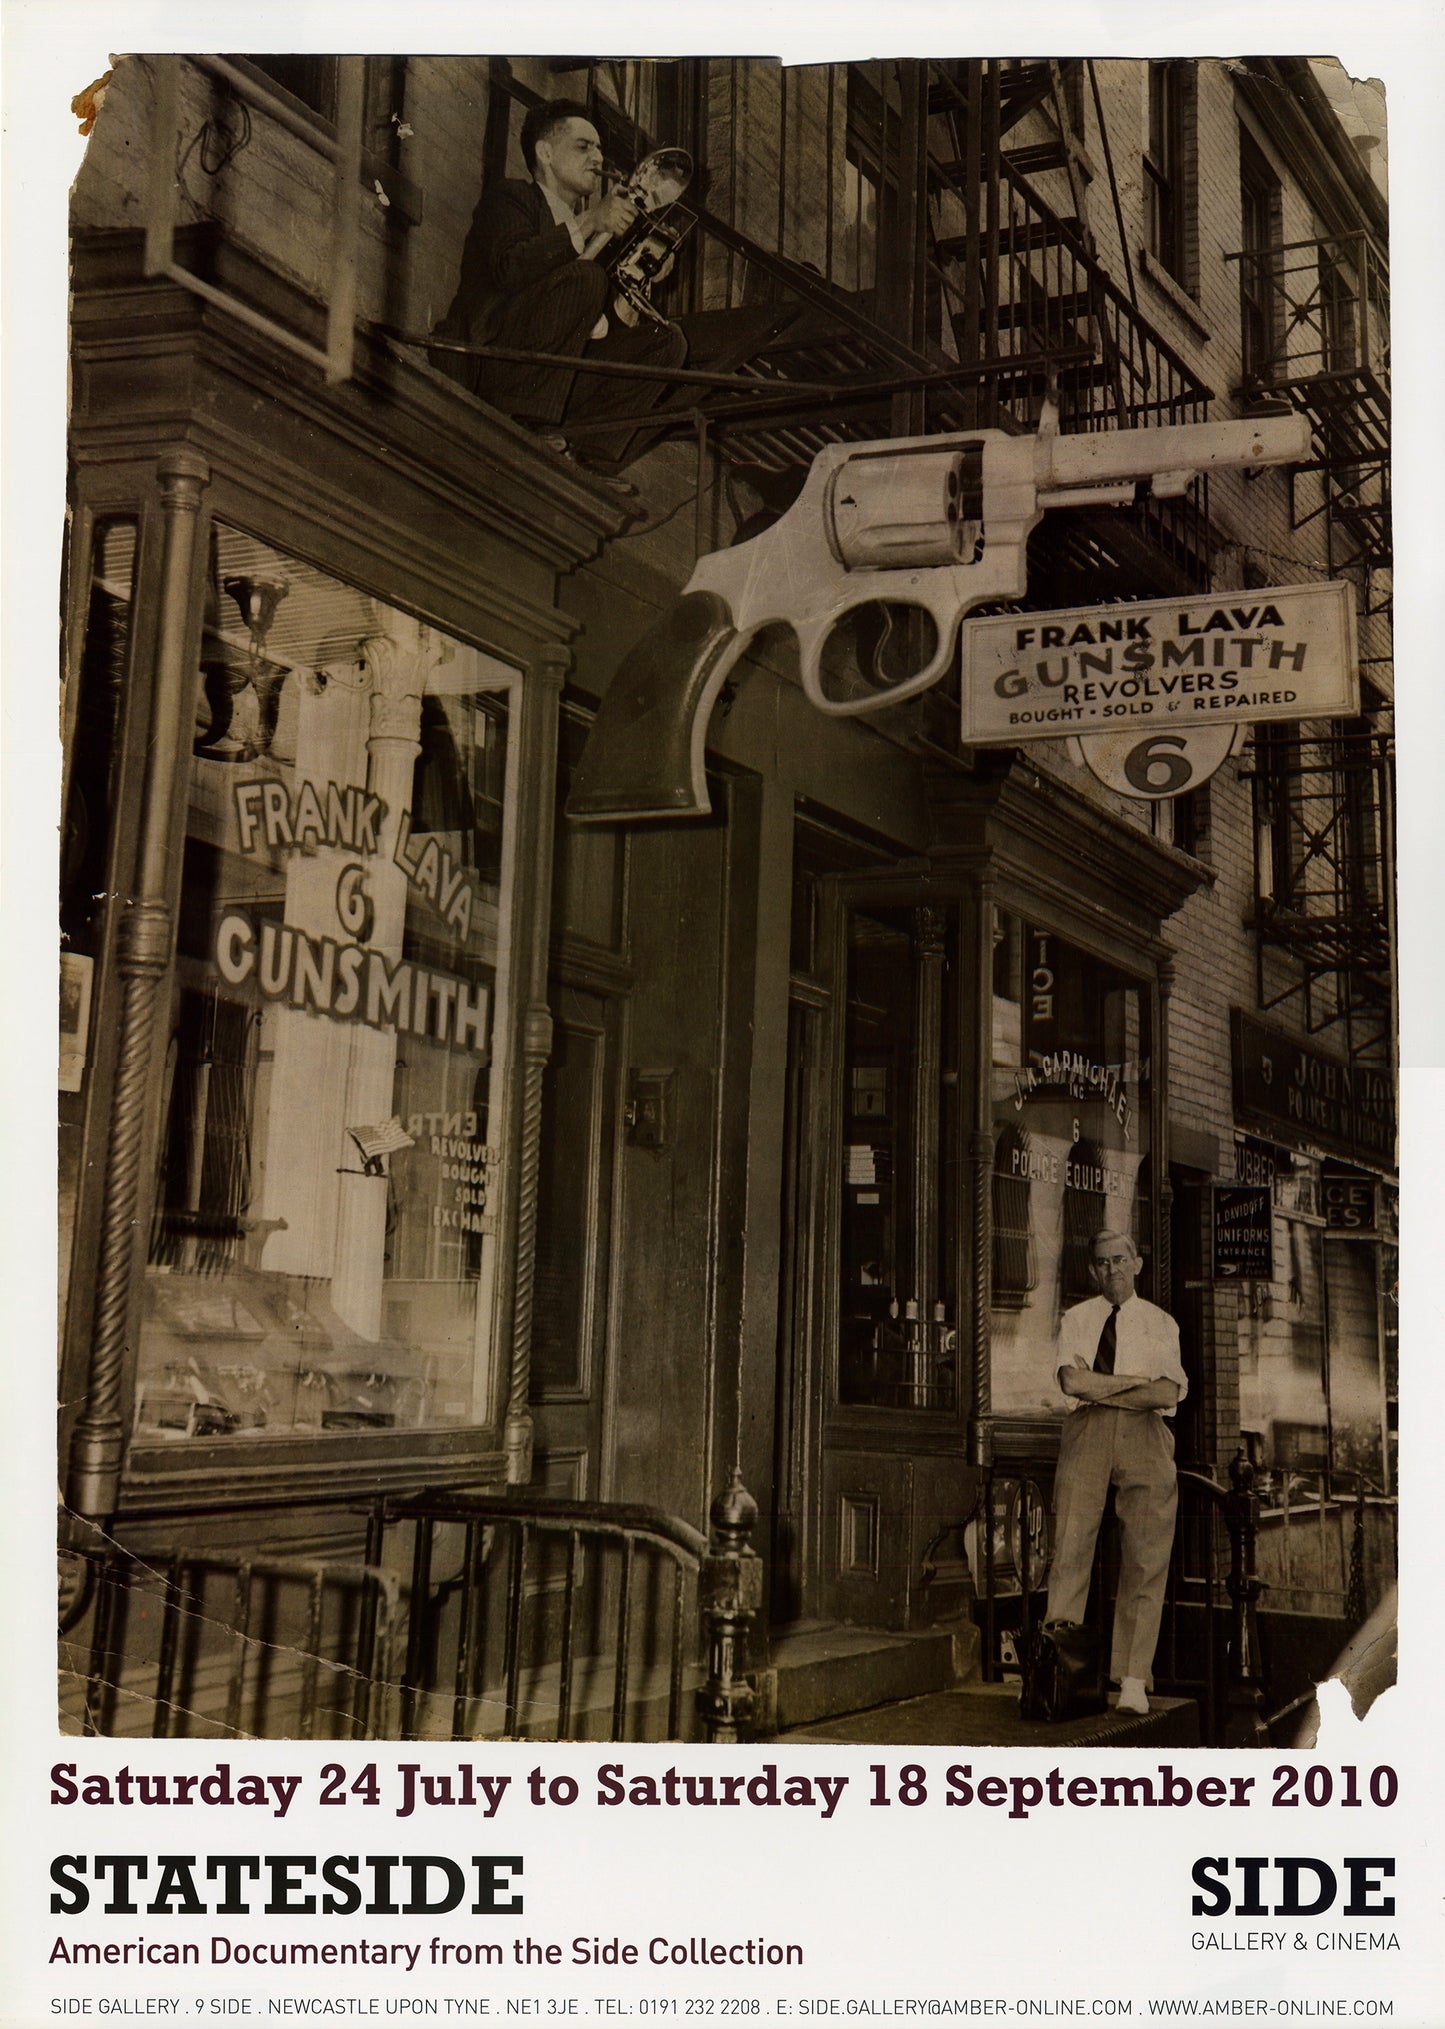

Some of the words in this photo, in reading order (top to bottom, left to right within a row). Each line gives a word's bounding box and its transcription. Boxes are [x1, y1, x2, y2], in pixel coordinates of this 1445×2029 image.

[1016, 617, 1152, 651] FRANK
[1178, 605, 1285, 636] LAVA
[993, 636, 1308, 700] GUNSMITH
[1062, 670, 1240, 705] REVOLVERS
[1008, 707, 1084, 725] BOUGHT
[1102, 701, 1154, 718] SOLD
[1193, 690, 1298, 710] REPAIRED
[1124, 735, 1193, 794] 6
[234, 779, 381, 855] FRANK
[393, 808, 474, 943] LAVA
[336, 863, 376, 943] 6
[216, 908, 492, 1056] GUNSMITH
[1294, 1053, 1351, 1105] JOHN
[1072, 1117, 1081, 1144] 6
[1012, 1148, 1059, 1185] POLICE
[1065, 1159, 1133, 1202] EQUIPMENT
[1326, 1185, 1368, 1206] CE
[455, 1186, 487, 1206] SOLD
[1224, 1195, 1265, 1223] DAVIDOFF
[1217, 1227, 1269, 1244] UNIFORMS
[1217, 1247, 1266, 1257] ENTRANCE
[51, 1763, 302, 1818] Saturday
[320, 1764, 380, 1806] 24
[396, 1764, 511, 1818] July
[527, 1766, 578, 1806] to
[598, 1764, 849, 1819] Saturday
[870, 1765, 928, 1806] 18
[946, 1765, 1255, 1819] September
[1272, 1765, 1398, 1807] 2010
[50, 1855, 524, 1916] STATESIDE
[1192, 1857, 1396, 1917] SIDE
[49, 1936, 200, 1965] American
[212, 1937, 421, 1972] Documentary
[430, 1936, 502, 1965] from
[513, 1937, 562, 1965] the
[572, 1936, 638, 1965] Side
[649, 1937, 803, 1966] Collection
[1192, 1932, 1286, 1951] GALLERY
[1294, 1932, 1308, 1951] &
[1316, 1932, 1401, 1951] CINEMA
[51, 1998, 93, 2015] SIDE
[99, 1998, 180, 2015] GALLERY
[196, 1998, 205, 2015] 9
[211, 1998, 252, 2015] SIDE
[269, 1998, 380, 2015] NEWCASTLE
[387, 1998, 438, 2015] UPON
[444, 1998, 490, 2015] TYNE
[507, 1998, 540, 2015] NE1
[548, 1998, 579, 2015] 3JE
[594, 1998, 633, 2015] TEL:
[640, 1998, 677, 2015] 0191
[686, 1998, 715, 2015] 232
[721, 1998, 761, 2015] 2208
[777, 1999, 793, 2015] E:
[799, 1999, 1132, 2016] SIDE.GALLERY@AMBER-ONLINE.COM
[1149, 1999, 1394, 2016] WWW.AMBER-ONLINE.COM
